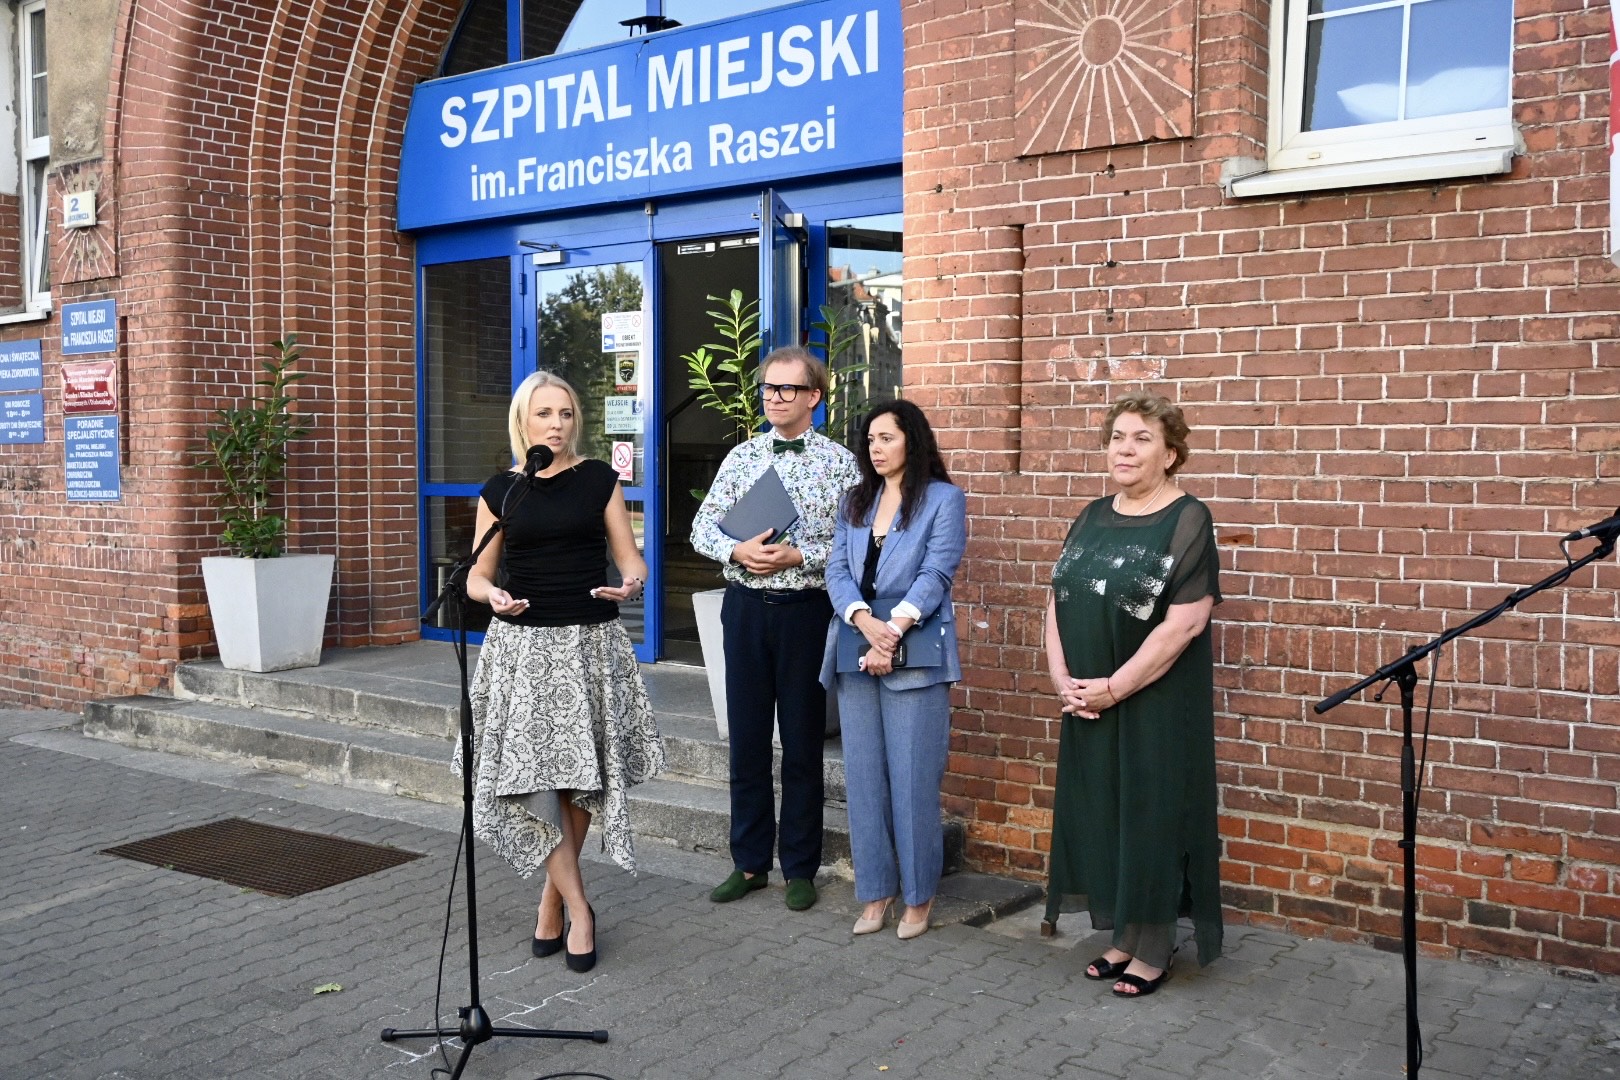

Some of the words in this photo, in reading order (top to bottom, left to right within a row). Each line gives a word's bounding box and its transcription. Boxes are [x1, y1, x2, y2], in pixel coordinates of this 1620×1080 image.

[440, 65, 632, 148] SZPITAL
[648, 10, 879, 113] MIEJSKI
[709, 105, 835, 167] Raszei
[70, 198, 79, 212] 2
[71, 311, 88, 326] SZPITAL
[88, 309, 106, 324] MIEJSKI
[70, 330, 97, 346] FRANCISZKA
[76, 419, 104, 429] PORADNIE
[66, 429, 115, 440] SPECJALISTYCZNE
